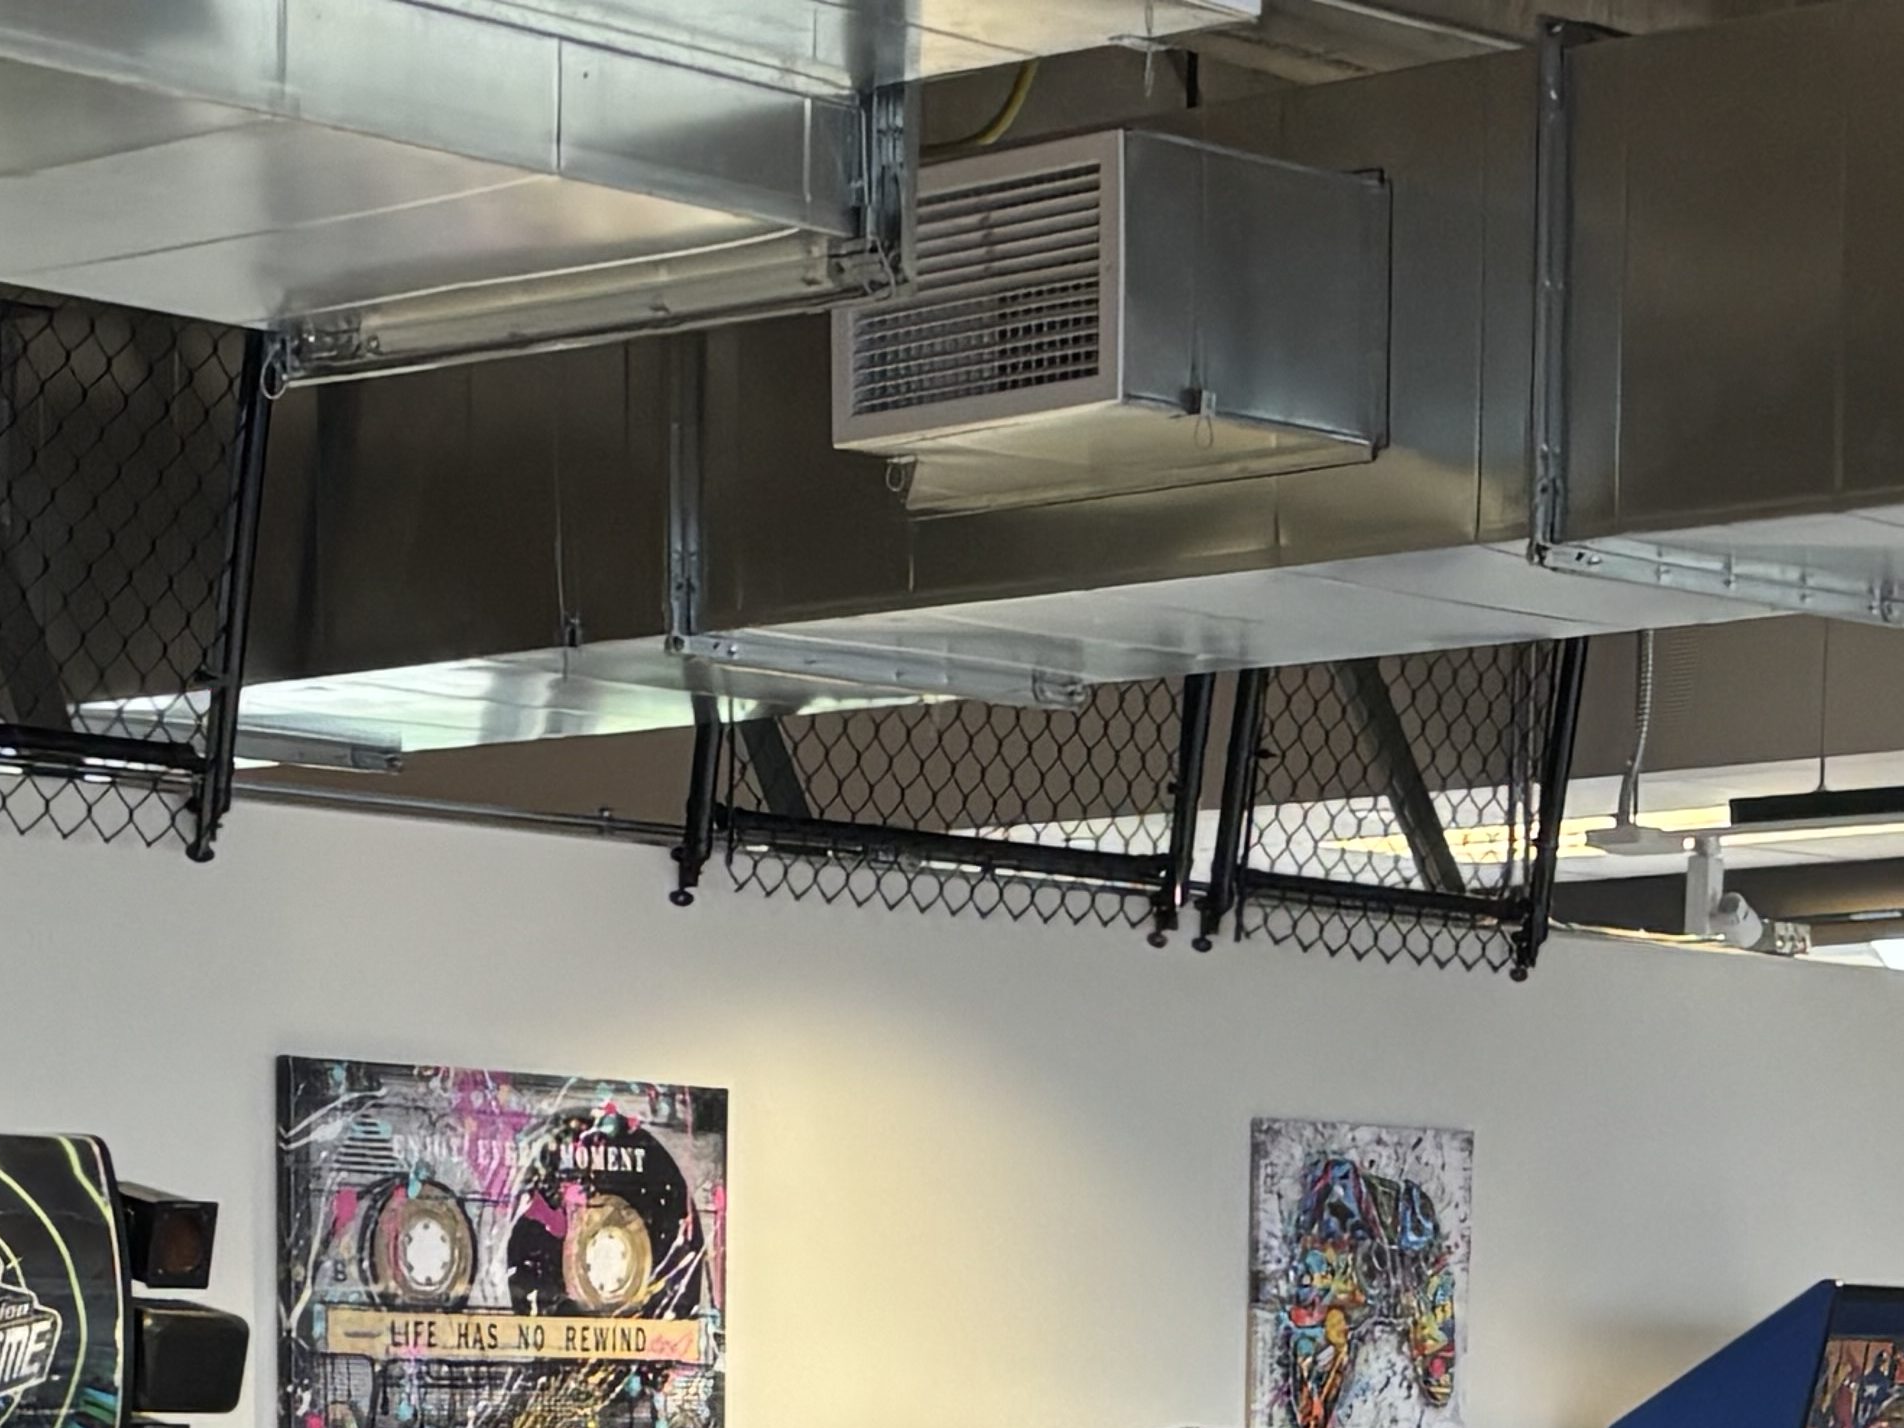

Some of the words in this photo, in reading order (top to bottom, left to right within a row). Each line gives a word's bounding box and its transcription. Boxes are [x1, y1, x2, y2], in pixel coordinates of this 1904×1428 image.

[559, 1143, 646, 1174] MOMENT
[389, 1320, 437, 1349] LIFE
[457, 1322, 499, 1351] HAS
[517, 1324, 546, 1352] NO
[565, 1326, 648, 1353] REWIND
